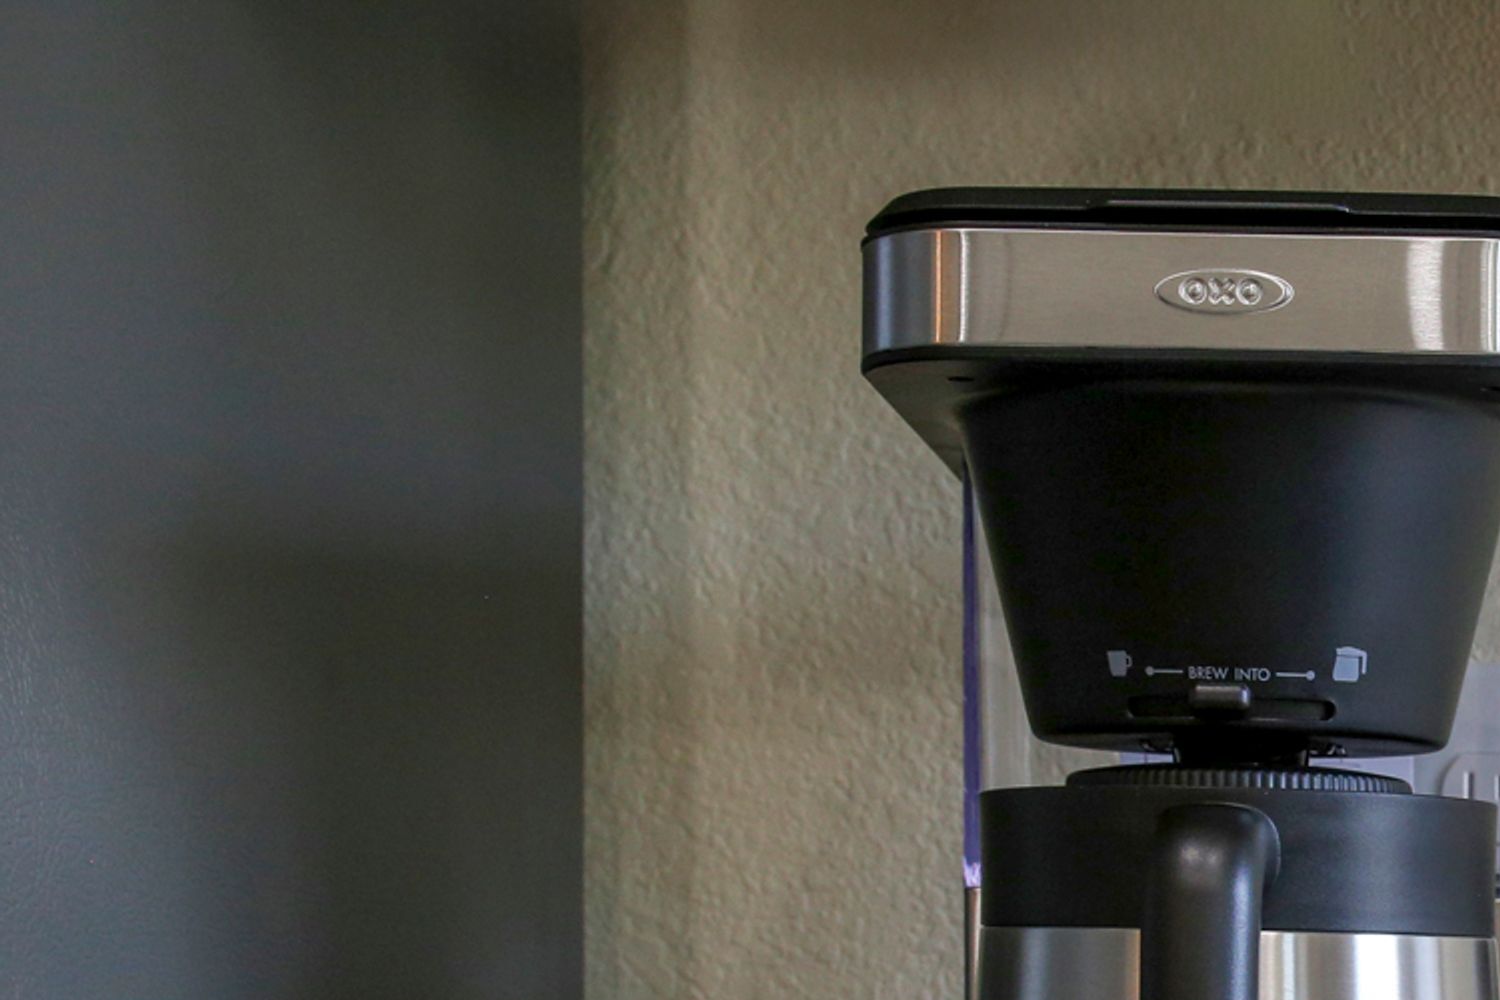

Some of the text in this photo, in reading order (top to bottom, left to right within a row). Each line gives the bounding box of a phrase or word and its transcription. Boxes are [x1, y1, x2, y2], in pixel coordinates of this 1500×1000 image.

[1178, 277, 1263, 305] OXO
[1188, 666, 1271, 681] BREW INTO
